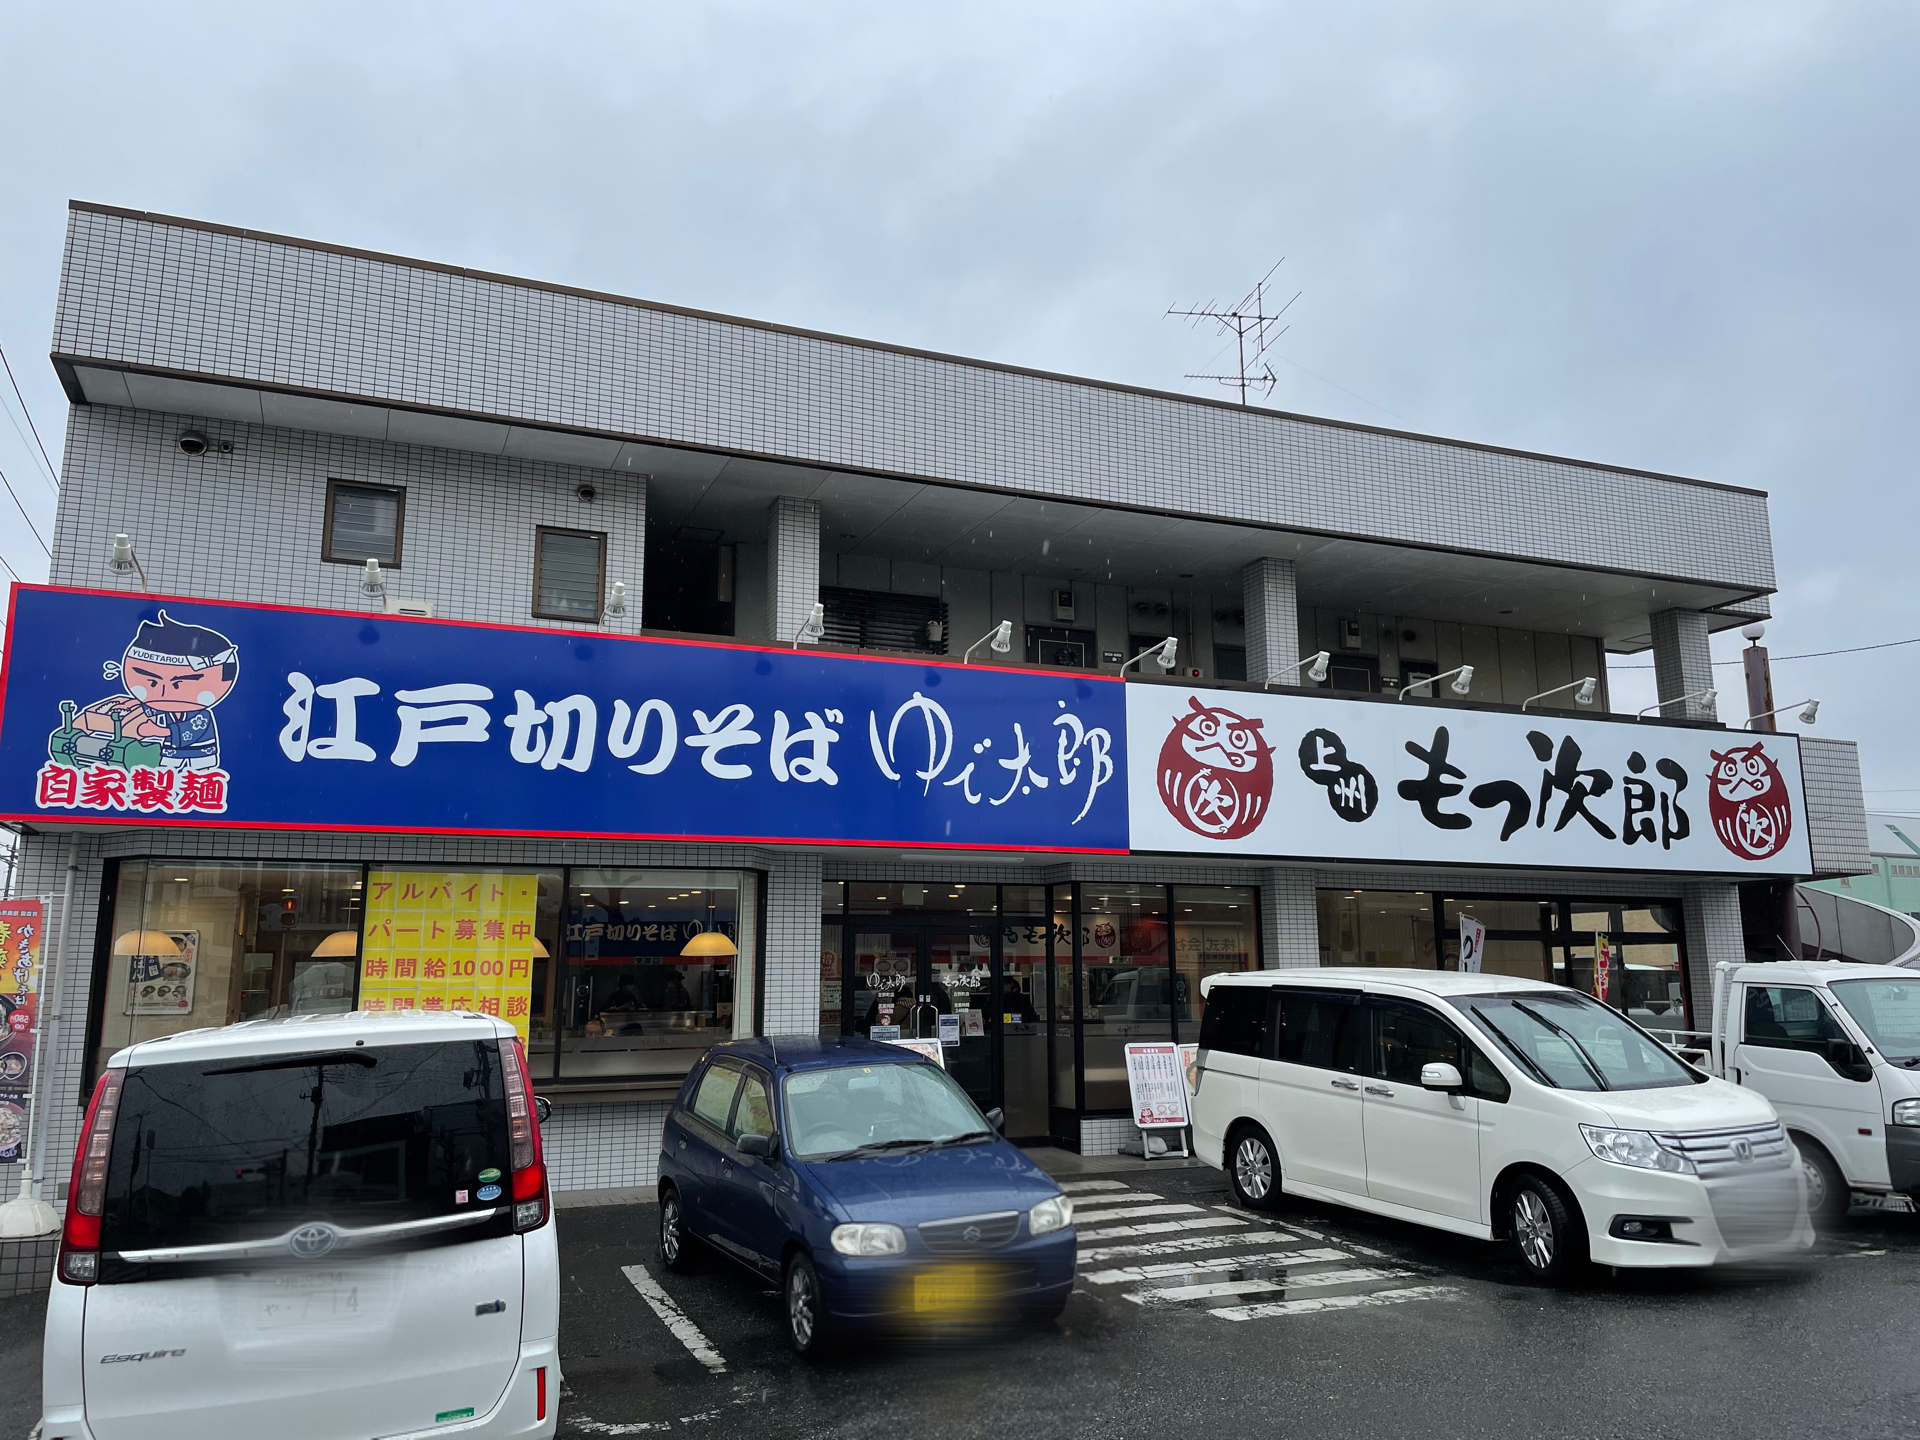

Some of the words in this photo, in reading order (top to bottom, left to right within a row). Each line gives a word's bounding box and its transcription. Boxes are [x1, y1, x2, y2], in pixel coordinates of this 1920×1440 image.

[133, 649, 185, 664] YUDETAROU
[279, 672, 843, 786] 江戸切りそば
[869, 691, 1114, 826] ゆで太郎
[39, 766, 224, 811] 自家製麺
[1304, 734, 1371, 816] 上州
[1400, 725, 1690, 850] もつ次郎
[371, 881, 528, 903] アルバイト・
[367, 918, 531, 941] パート募集中
[365, 957, 529, 980] 時間給1000円
[866, 971, 906, 992] ゆで太郎
[942, 974, 981, 987] もつ次郎
[100, 1348, 187, 1364] Esquire
